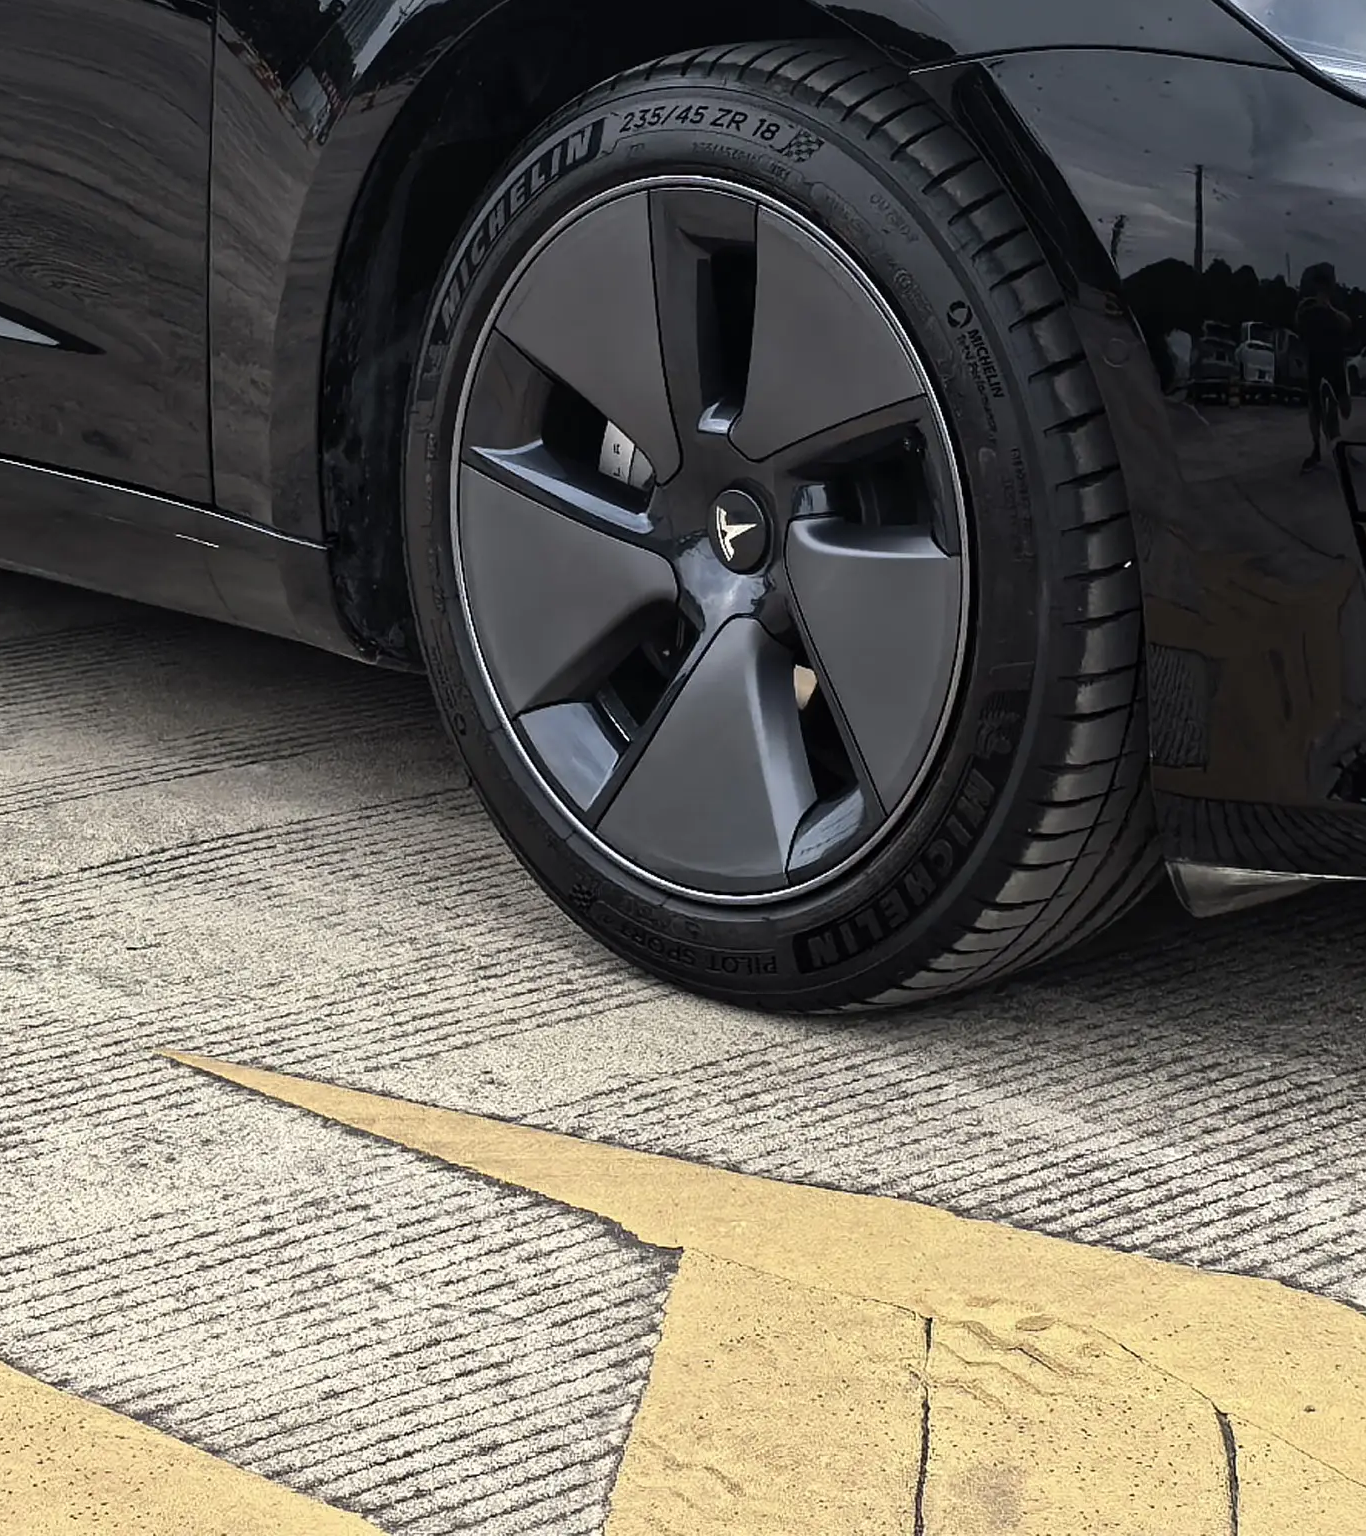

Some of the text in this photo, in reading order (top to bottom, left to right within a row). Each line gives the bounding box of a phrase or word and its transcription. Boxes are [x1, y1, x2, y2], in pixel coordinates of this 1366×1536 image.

[620, 105, 781, 142] 235/45 ZR 18
[440, 119, 597, 330] MICHELIN
[967, 328, 1005, 399] MICHELIN
[807, 767, 996, 964] MICHELIN
[704, 951, 778, 975] PILOT
